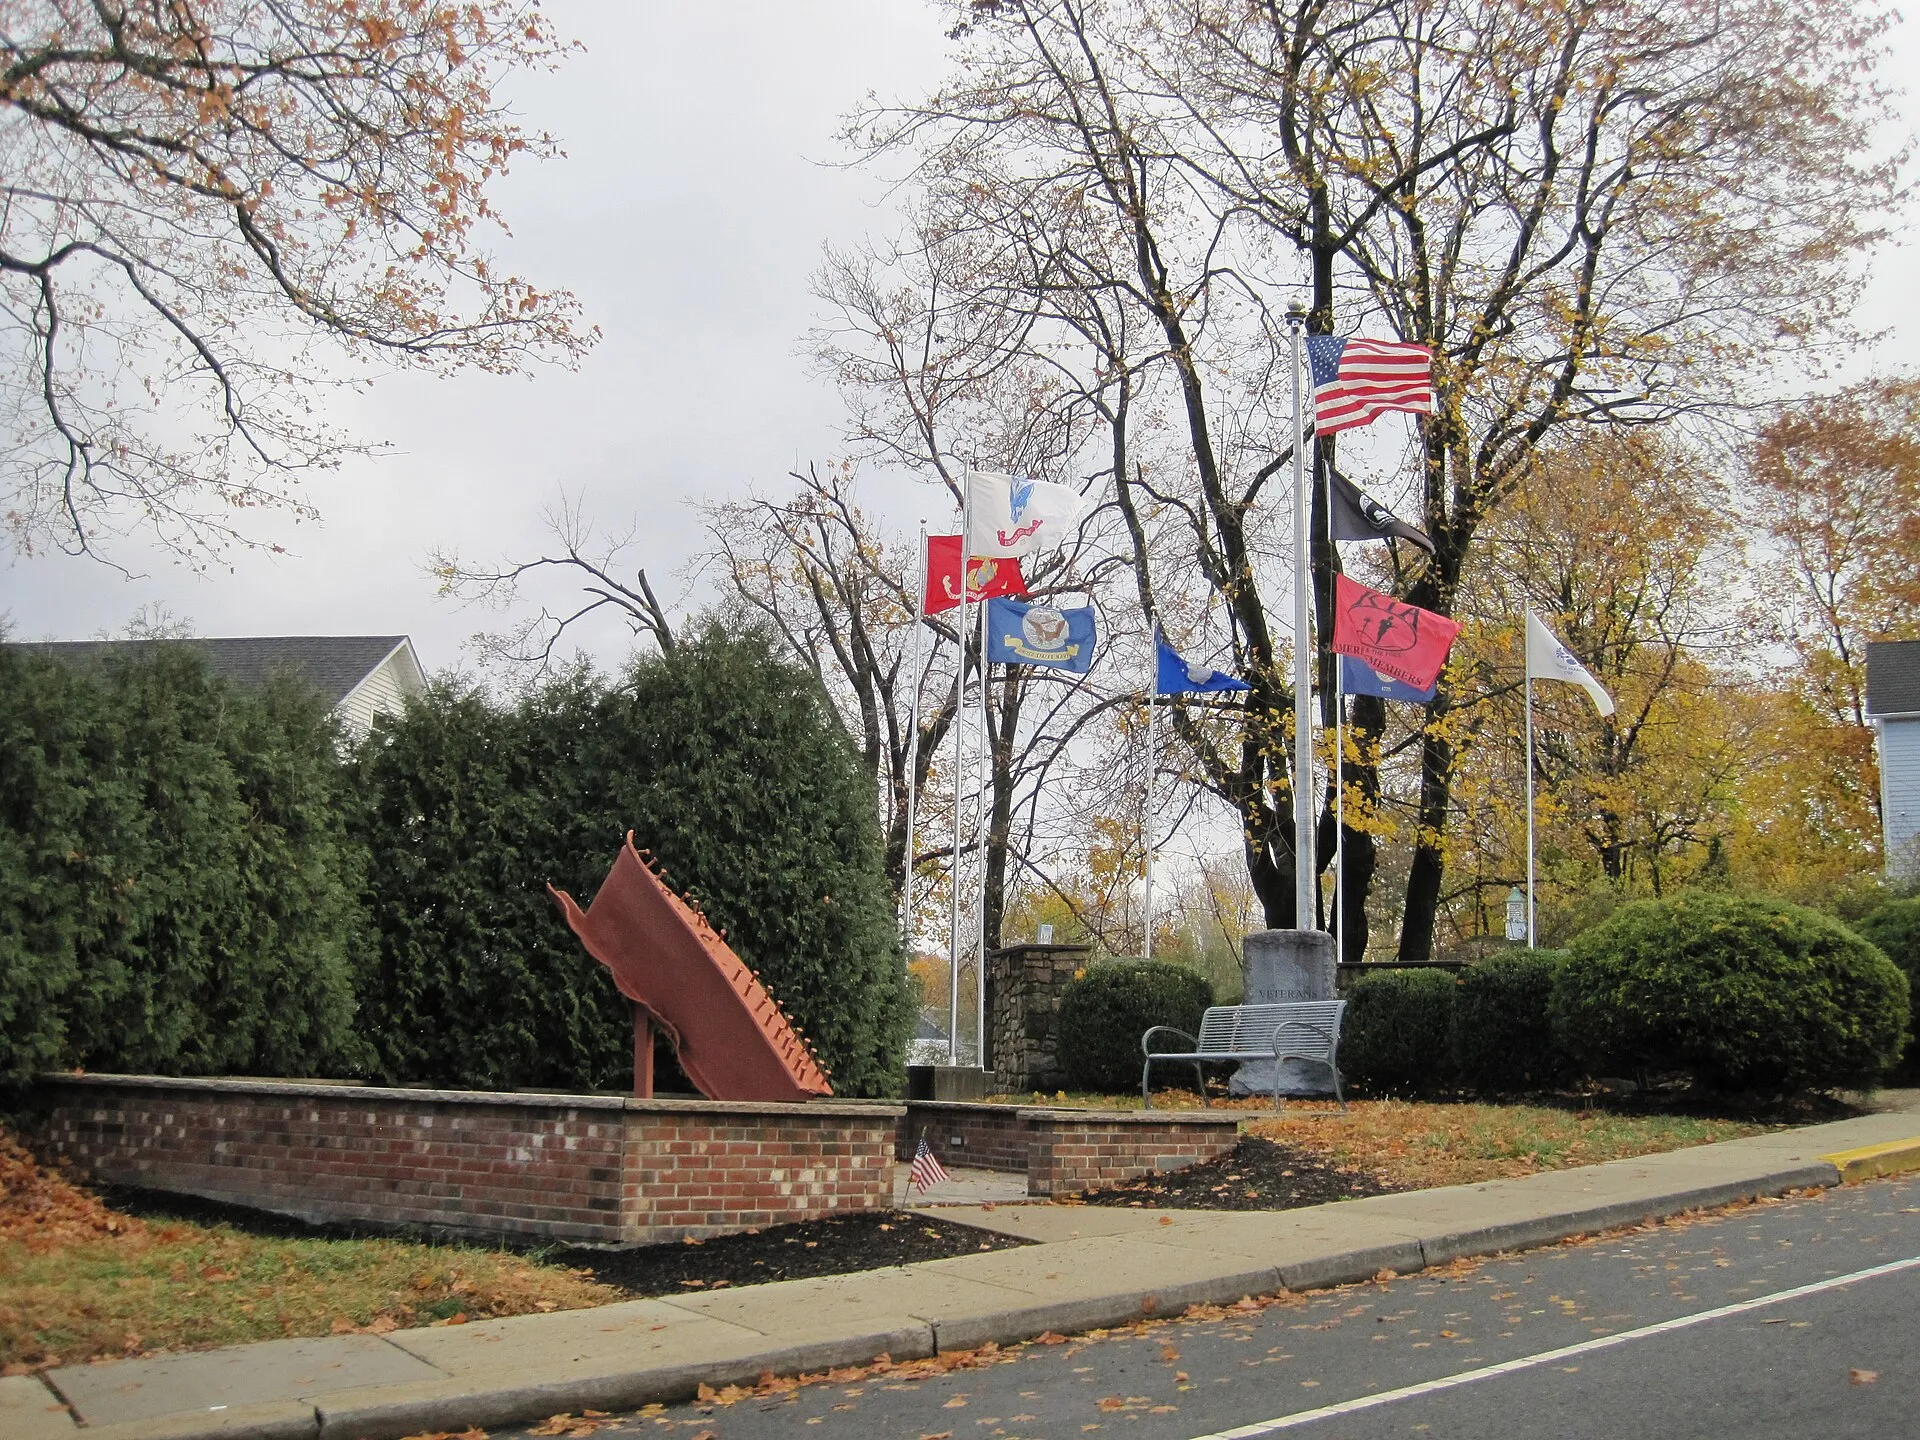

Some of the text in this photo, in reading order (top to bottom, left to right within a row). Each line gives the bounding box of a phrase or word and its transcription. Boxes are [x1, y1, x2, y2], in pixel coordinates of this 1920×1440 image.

[1351, 591, 1419, 630] KIA
[1366, 656, 1422, 685] MEMBERS
[1260, 989, 1318, 998] VETERANS
